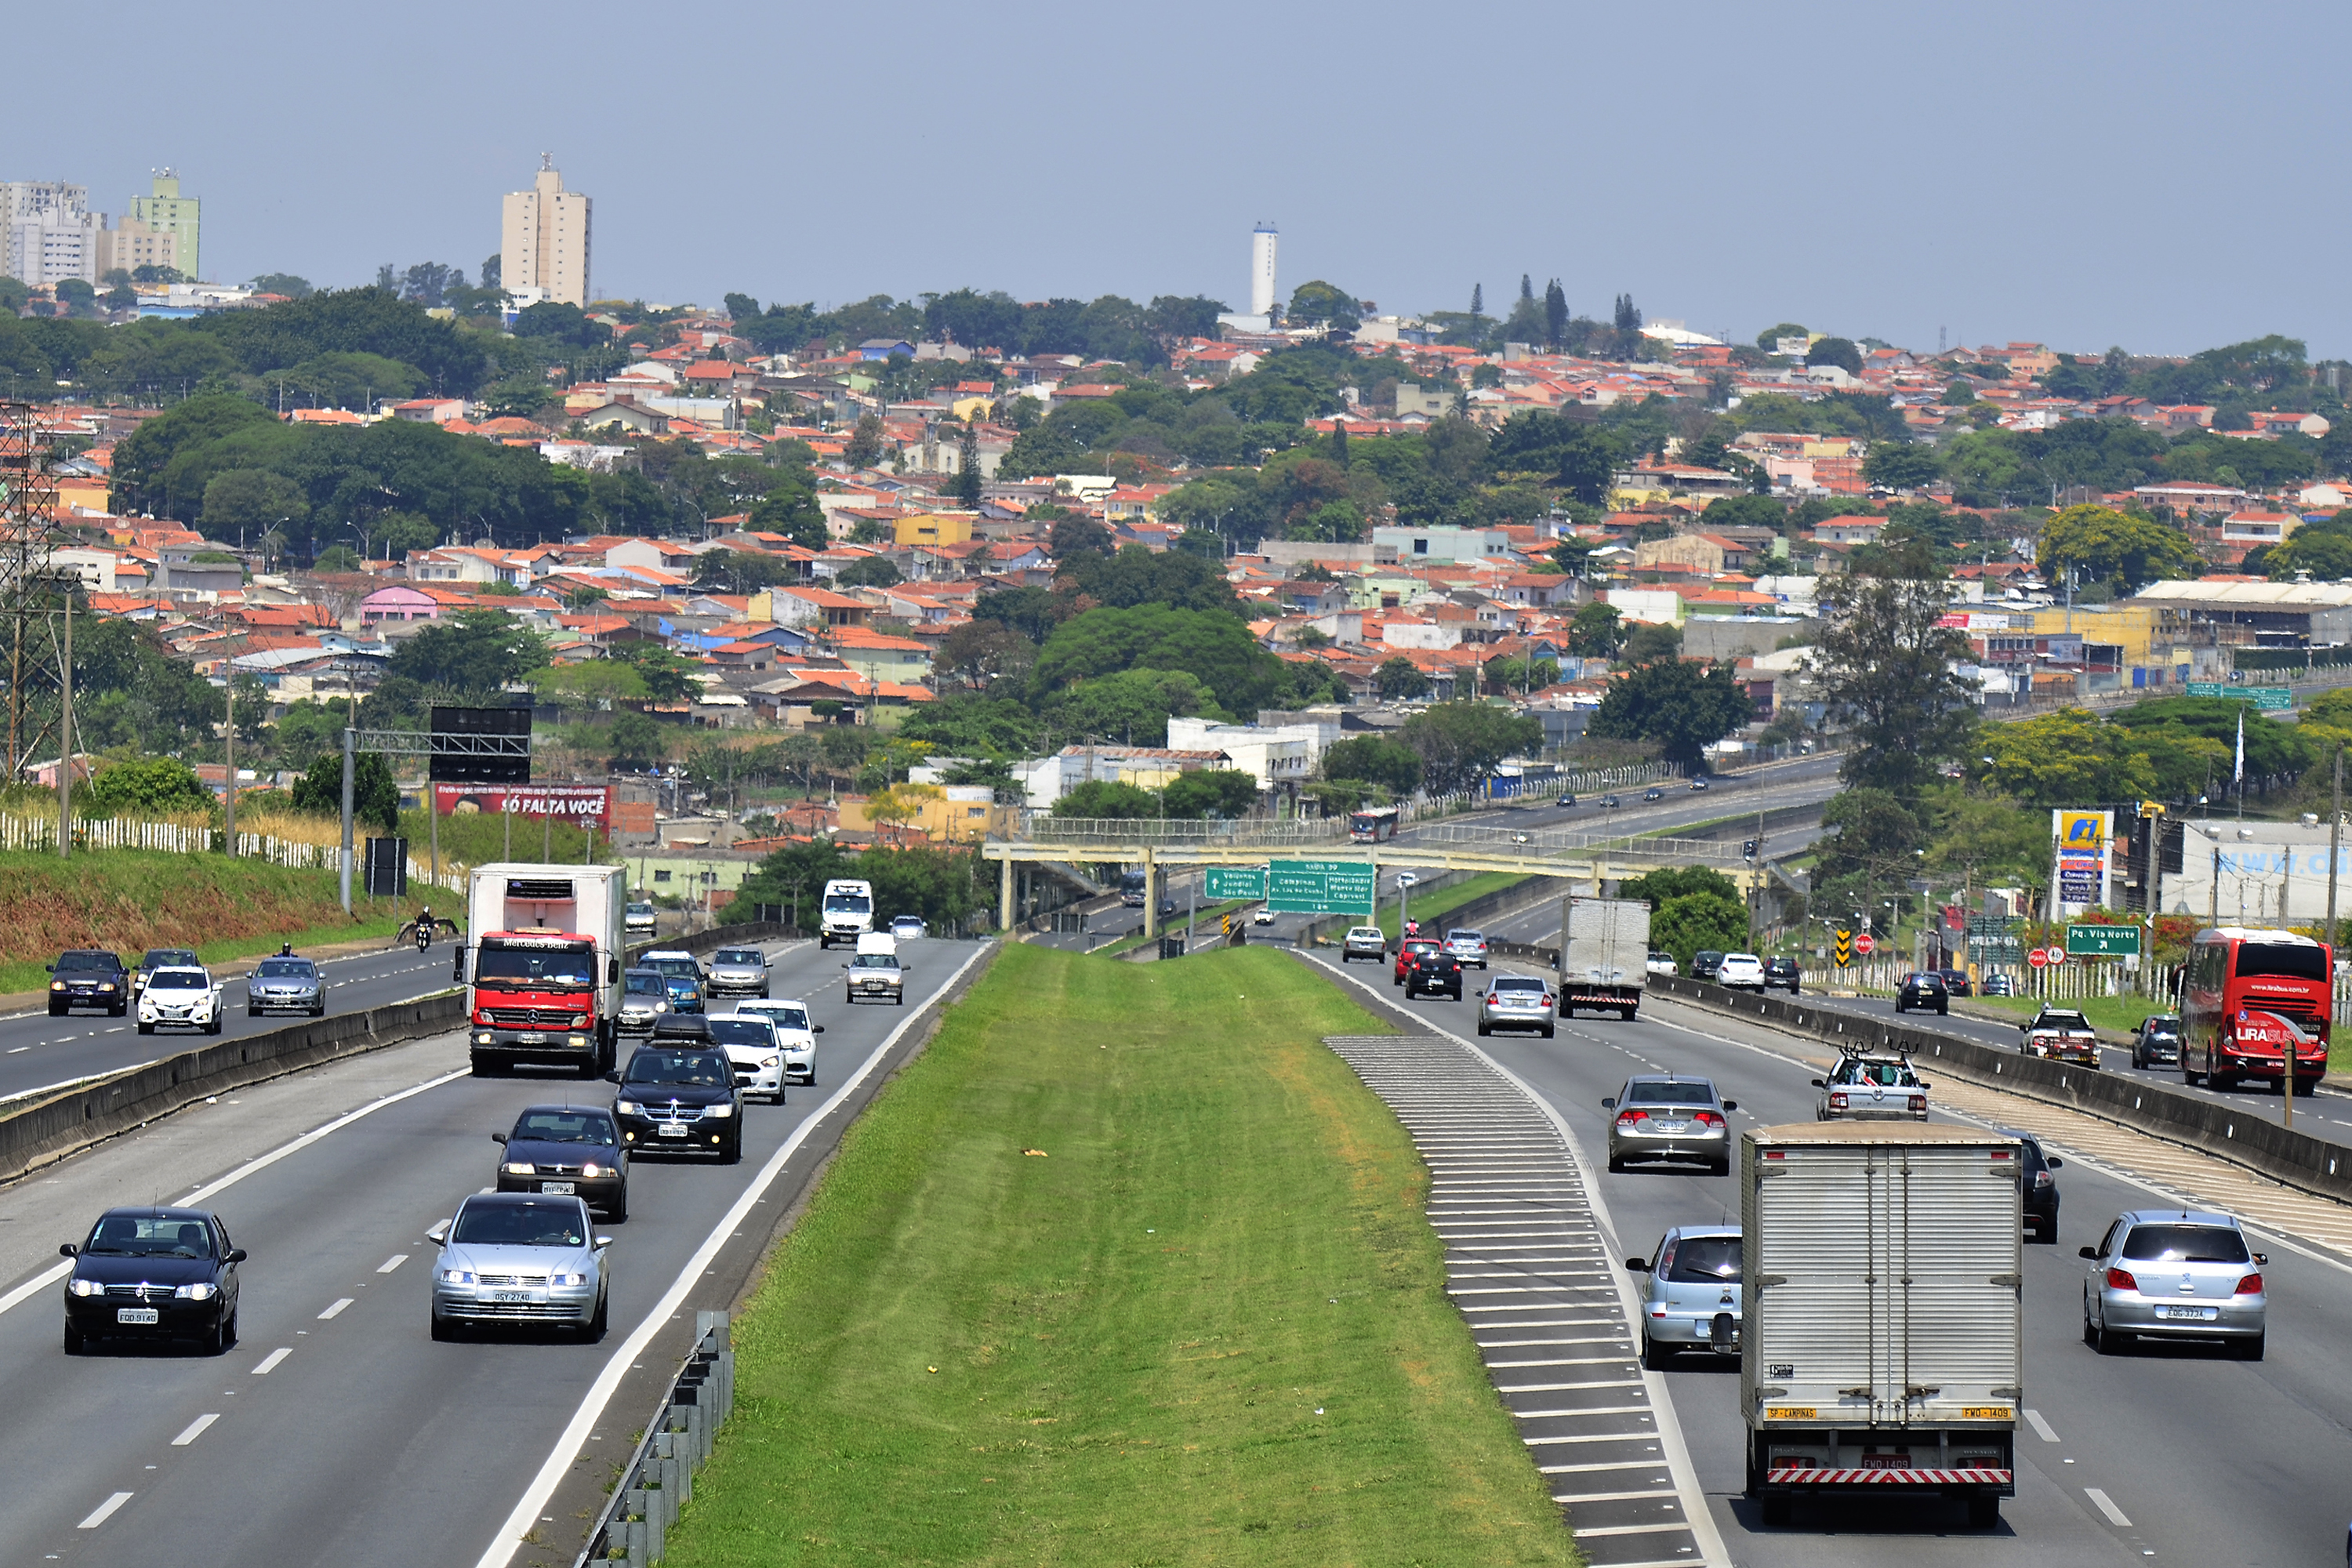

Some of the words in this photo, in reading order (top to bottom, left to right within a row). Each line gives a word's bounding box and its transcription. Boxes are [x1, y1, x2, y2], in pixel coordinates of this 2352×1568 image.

[502, 794, 520, 814] SÓ
[522, 799, 566, 815] FALTA
[568, 795, 605, 815] VOCÊ
[1279, 878, 1316, 887] Campinas
[2071, 929, 2086, 938] Pq.
[2089, 930, 2106, 938] Via
[2236, 1027, 2296, 1044] LIRABUS
[1770, 1409, 1778, 1417] SP
[1784, 1409, 1813, 1417] CAMPINAS
[1989, 1408, 2009, 1417] 1409
